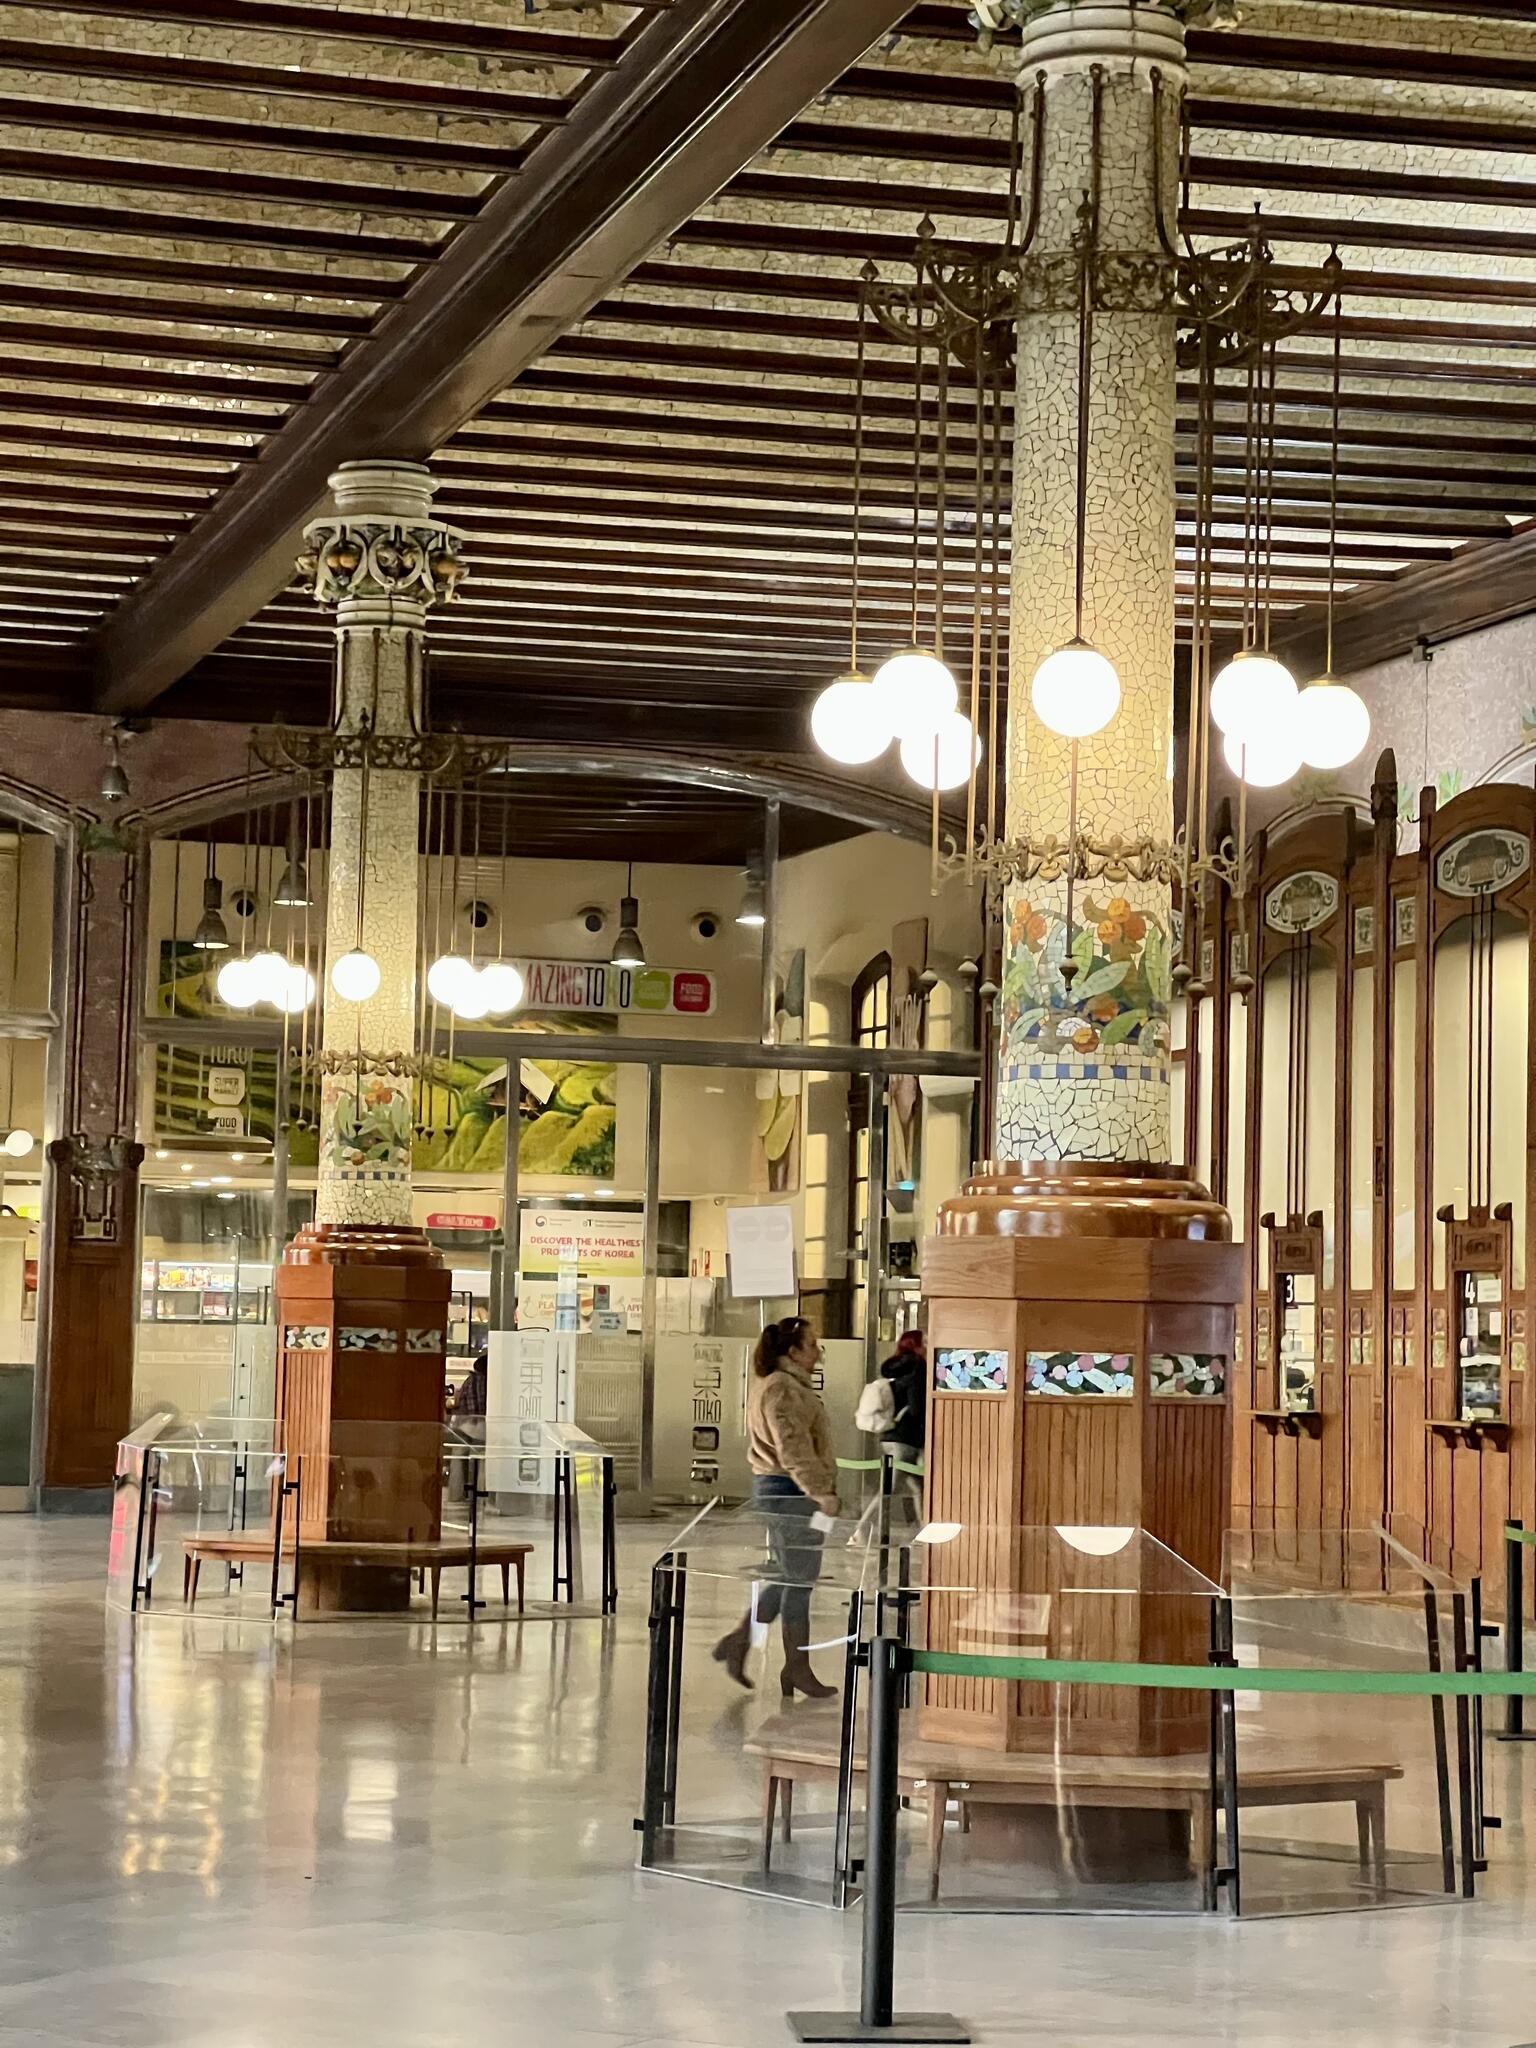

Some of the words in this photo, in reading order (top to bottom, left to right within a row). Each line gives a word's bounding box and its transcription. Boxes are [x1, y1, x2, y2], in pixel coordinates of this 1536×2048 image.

[530, 1236, 572, 1245] DISCOVER
[576, 1237, 592, 1246] THE
[541, 1247, 587, 1257] PROTS
[590, 1249, 601, 1257] OF
[604, 1249, 635, 1258] KOREA
[1286, 1274, 1295, 1304] 3
[1464, 1273, 1476, 1304] 4
[692, 1398, 722, 1424] TOKO
